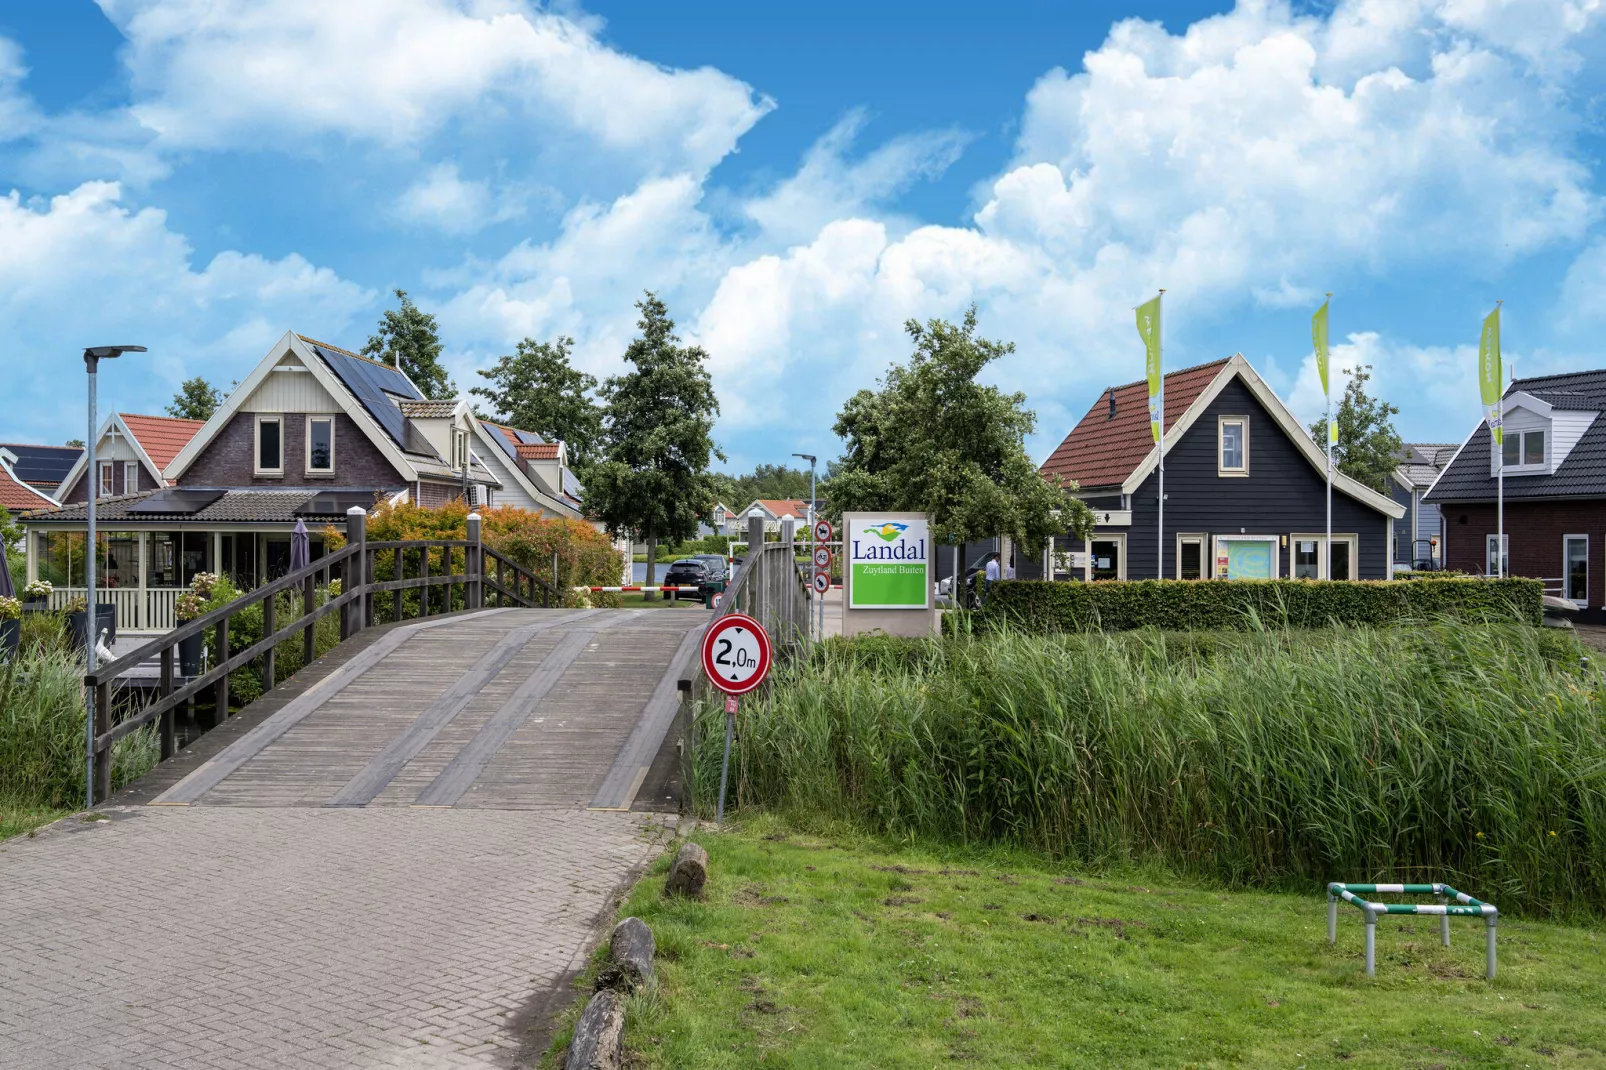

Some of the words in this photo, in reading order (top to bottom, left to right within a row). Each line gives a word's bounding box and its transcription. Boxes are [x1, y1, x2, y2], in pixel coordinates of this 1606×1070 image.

[852, 538, 926, 560] Landal
[862, 565, 897, 577] Zuytland
[899, 565, 924, 575] Buiten
[715, 638, 756, 669] 2,0m
